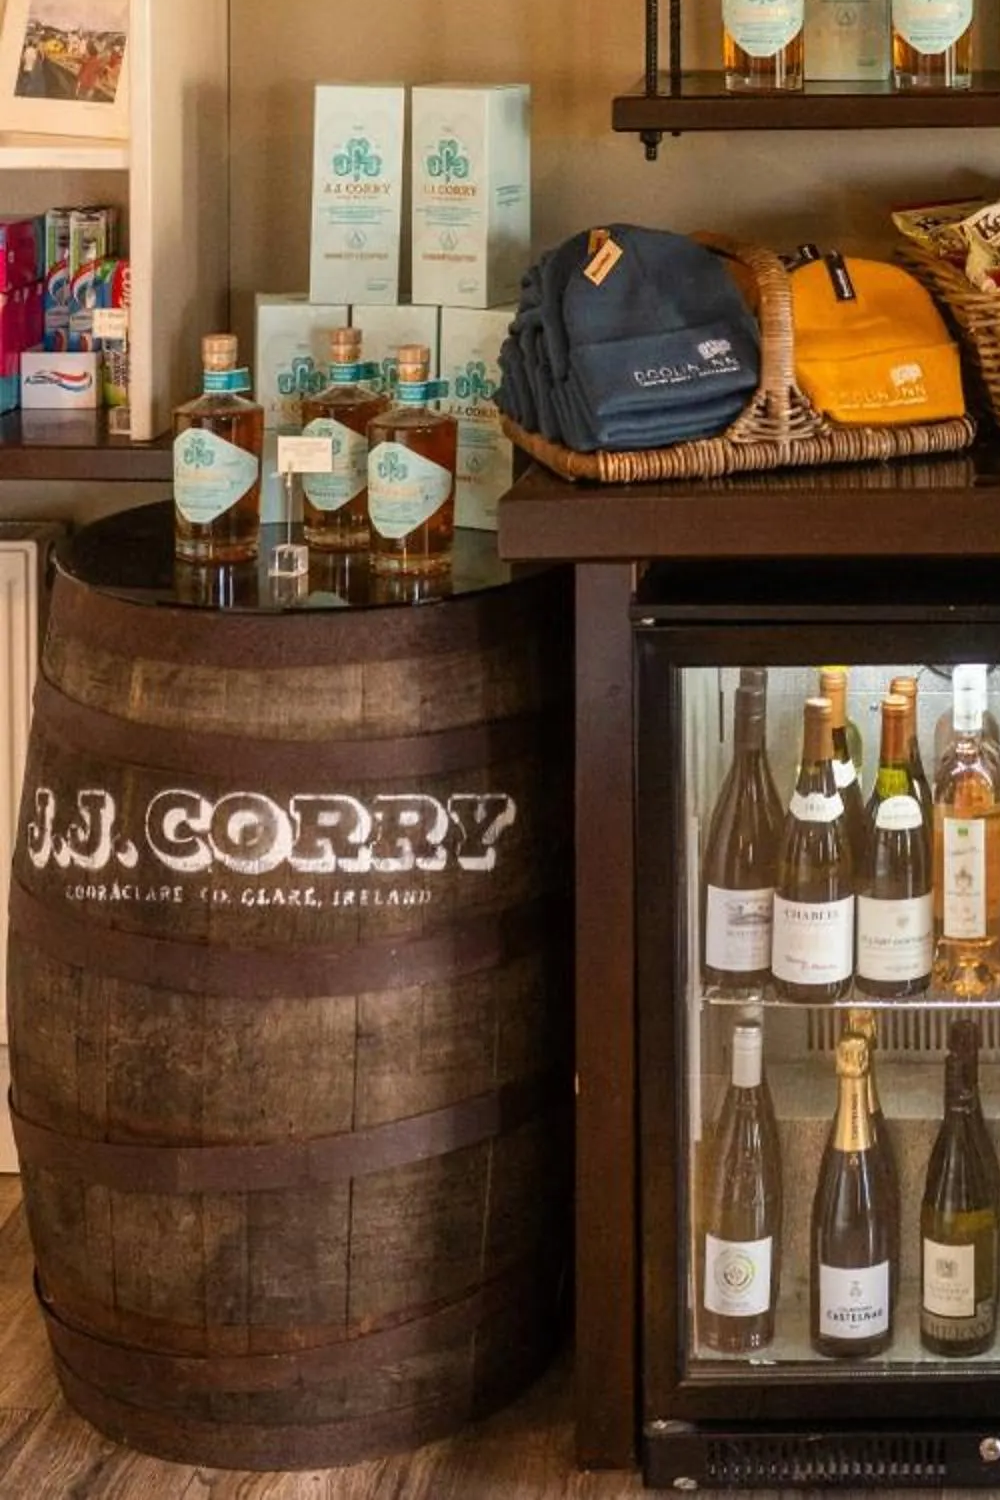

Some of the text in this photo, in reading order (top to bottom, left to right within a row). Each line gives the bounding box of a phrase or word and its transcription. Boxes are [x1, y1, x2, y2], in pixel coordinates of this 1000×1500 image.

[27, 787, 517, 876] J.J. CORRY
[331, 885, 433, 908] IRELAND
[825, 1307, 885, 1324] CASTELNAU
